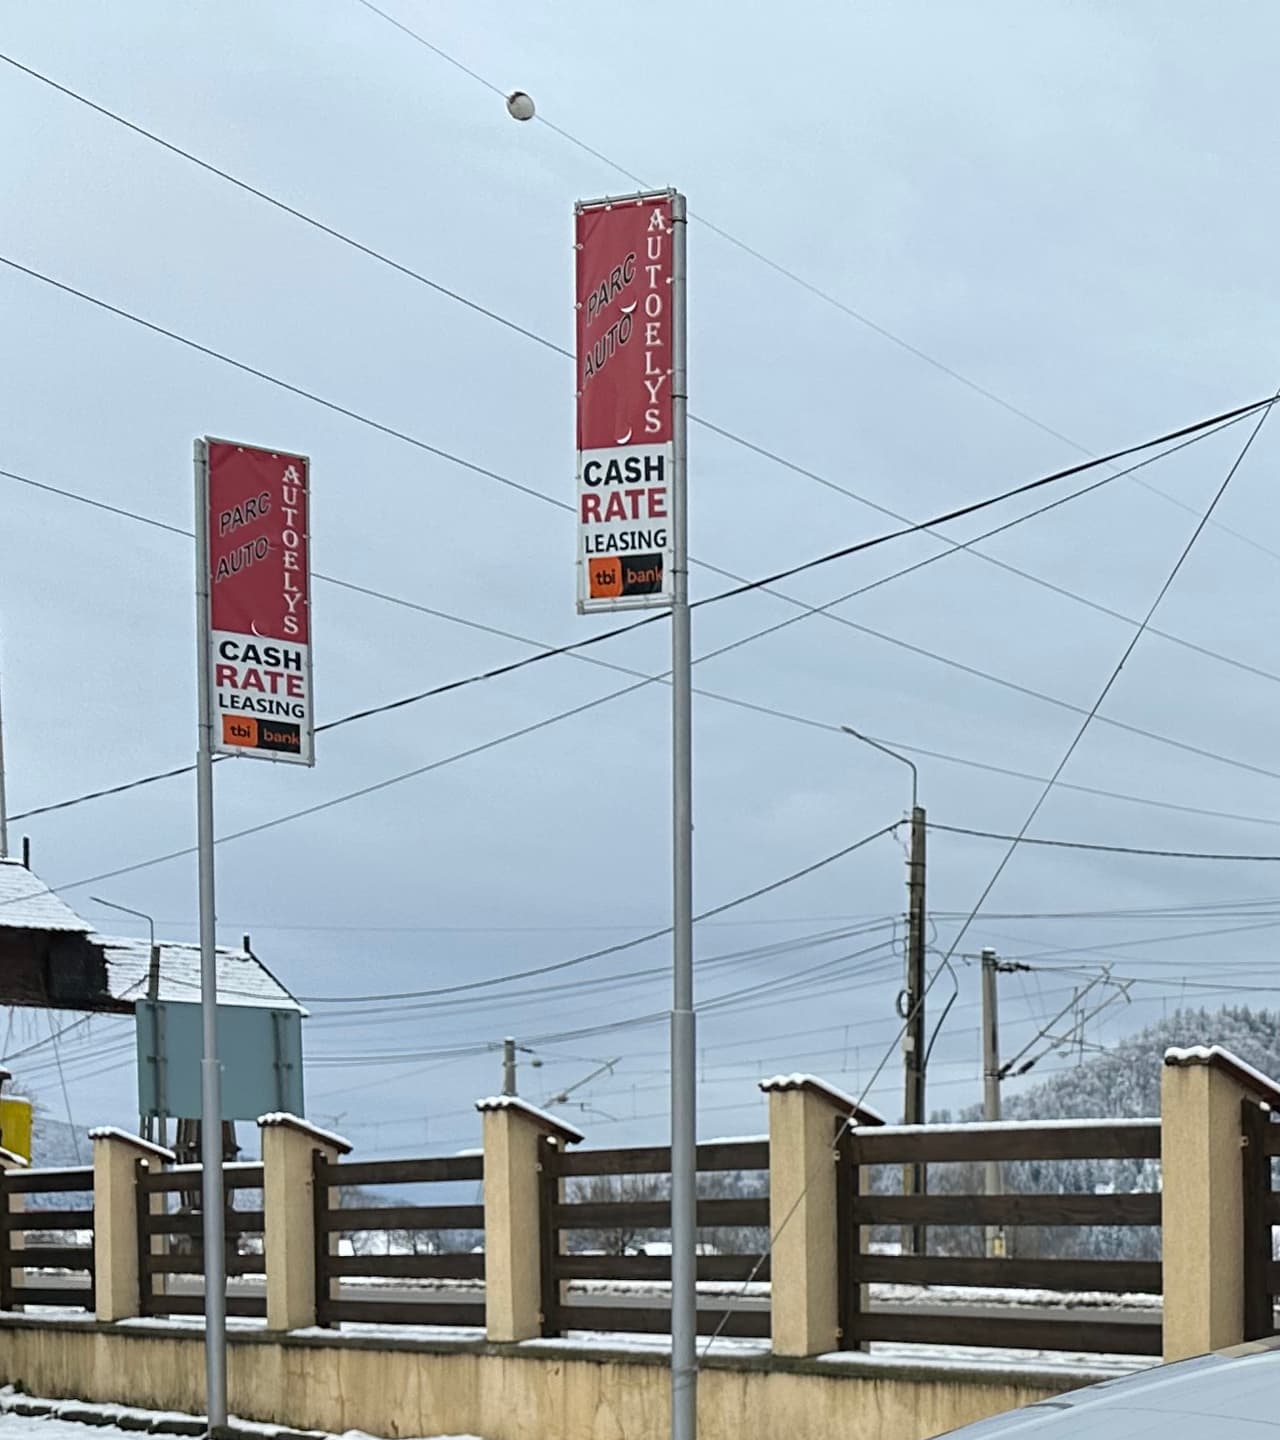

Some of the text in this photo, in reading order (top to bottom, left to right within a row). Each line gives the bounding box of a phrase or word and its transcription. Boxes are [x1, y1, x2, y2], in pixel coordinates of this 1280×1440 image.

[587, 252, 636, 327] PARC
[644, 208, 666, 433] AUTOELYS
[583, 311, 632, 382] AUTO
[583, 455, 664, 487] CASH
[218, 491, 271, 537] PARC
[581, 487, 668, 524] RATE
[281, 464, 302, 635] AUTOELYS
[585, 529, 667, 554] LEASING
[215, 536, 270, 583] AUTO
[595, 566, 663, 585] tbi bank
[219, 640, 301, 671] CASH
[215, 664, 305, 698] RATE
[218, 693, 305, 718] LEASING
[230, 725, 300, 745] tbi bank
